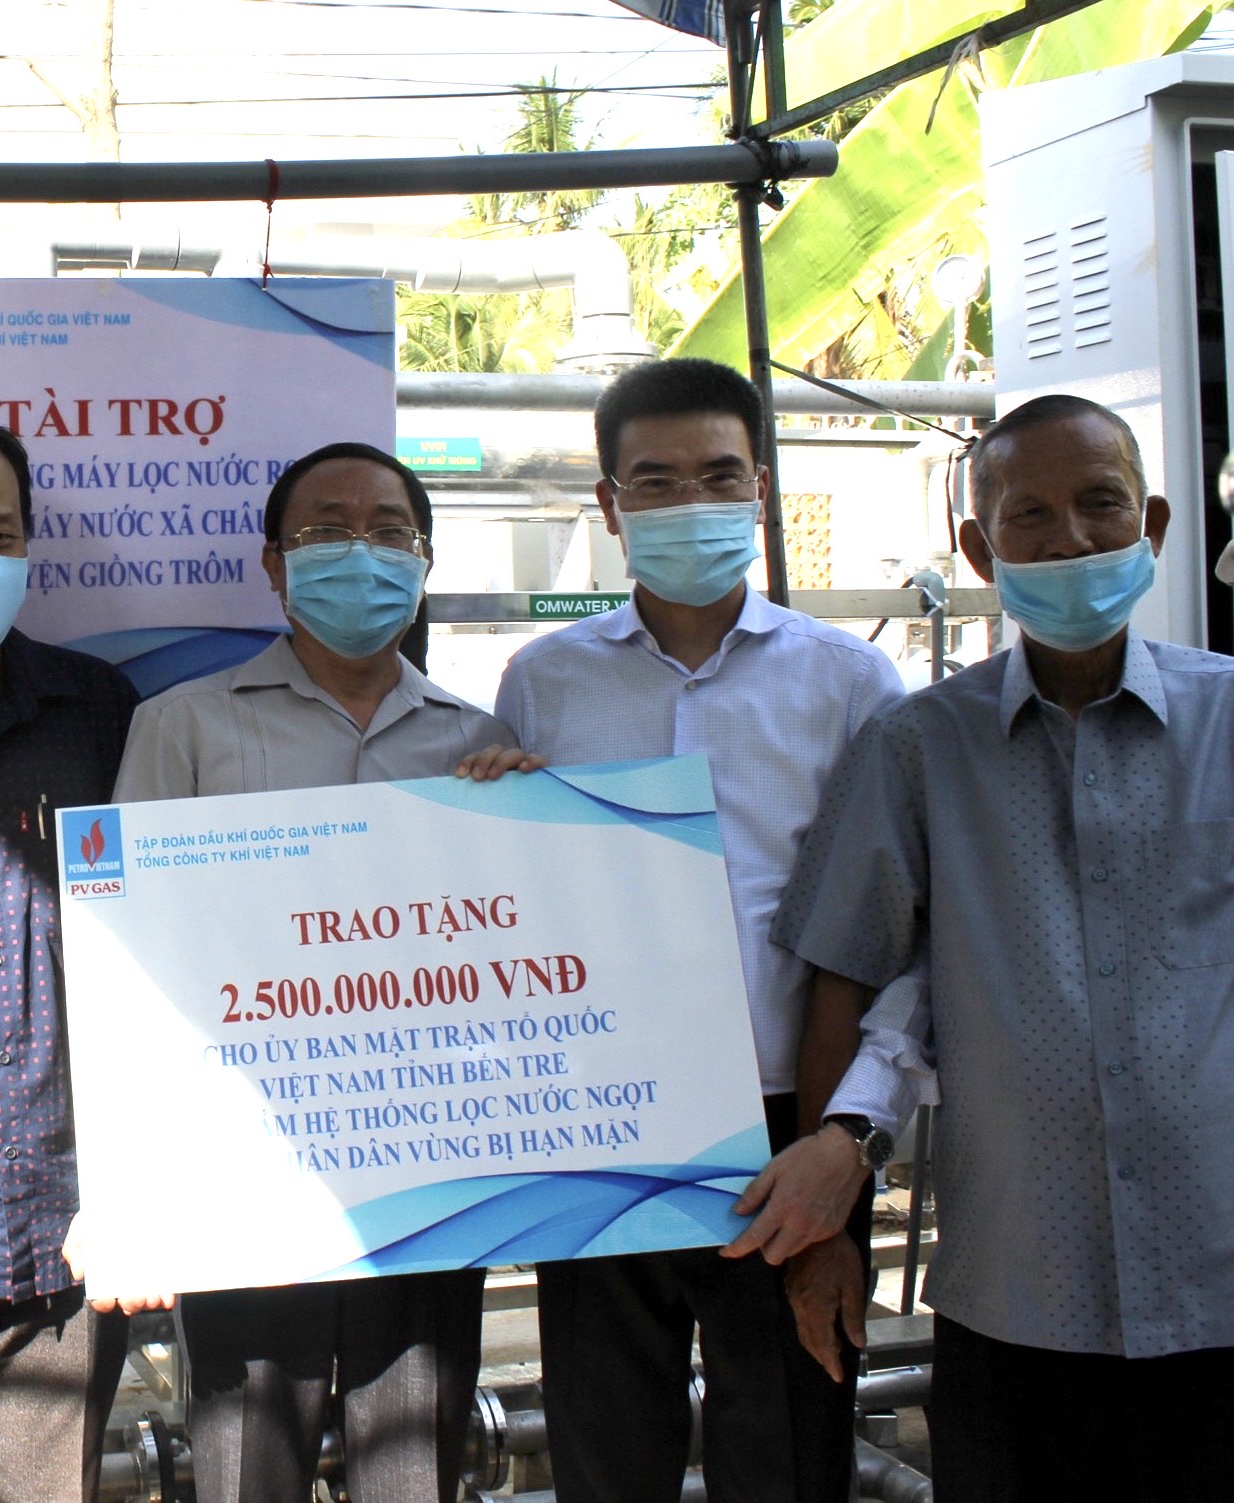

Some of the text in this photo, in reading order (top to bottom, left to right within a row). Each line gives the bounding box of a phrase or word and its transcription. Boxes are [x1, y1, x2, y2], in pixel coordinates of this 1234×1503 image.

[7, 310, 44, 327] QUỐC
[47, 313, 69, 326] GIA
[72, 311, 101, 328] VIỆT
[103, 313, 132, 326] NAM
[9, 331, 38, 347] VIỆT
[41, 334, 68, 346] NAM
[108, 395, 226, 446] TRỢ
[62, 455, 121, 490] MÁY
[127, 461, 180, 494] LỌC
[186, 453, 259, 487] NƯỚC
[29, 503, 74, 539] ÁY
[79, 503, 153, 539] NƯỚC
[160, 504, 195, 537] XÃ
[78, 554, 164, 588] GIỒNG
[169, 551, 244, 585] TRÔM
[535, 600, 630, 613] OMWATER.V
[135, 835, 157, 851] TẬP
[162, 833, 195, 849] ĐOÀN
[227, 828, 247, 844] KHÍ
[251, 825, 285, 842] QUỐC
[288, 827, 309, 839] GIA
[312, 822, 338, 838] VIỆT
[341, 821, 367, 834] NAM
[136, 844, 310, 868] TỔNG CÔNG TY KHÍ VIỆT NAM
[71, 881, 120, 896] PV GAS
[291, 895, 518, 946] TRAO TẶNG
[220, 954, 587, 1023] 2.500.000.000 VNĐ
[264, 1034, 299, 1063] ỦY
[305, 1034, 357, 1060] BAN
[365, 1027, 421, 1058] MẶT
[426, 1020, 497, 1052] TRẬN
[502, 1011, 538, 1042] TỔ
[544, 1006, 618, 1042] QUỐC
[259, 1052, 569, 1104] VIỆT NAM TỈNH BẾN TRE
[304, 1106, 340, 1139] HỆ
[345, 1098, 438, 1131] THỐNG
[446, 1096, 498, 1127] LỌC
[505, 1083, 581, 1117] NƯỚC
[586, 1080, 657, 1111] NGỌT
[347, 1137, 401, 1169] DÂN
[407, 1132, 480, 1163] VÙNG
[487, 1132, 513, 1161] BỊ
[520, 1126, 575, 1157] HẠN
[581, 1118, 640, 1151] MẶN
